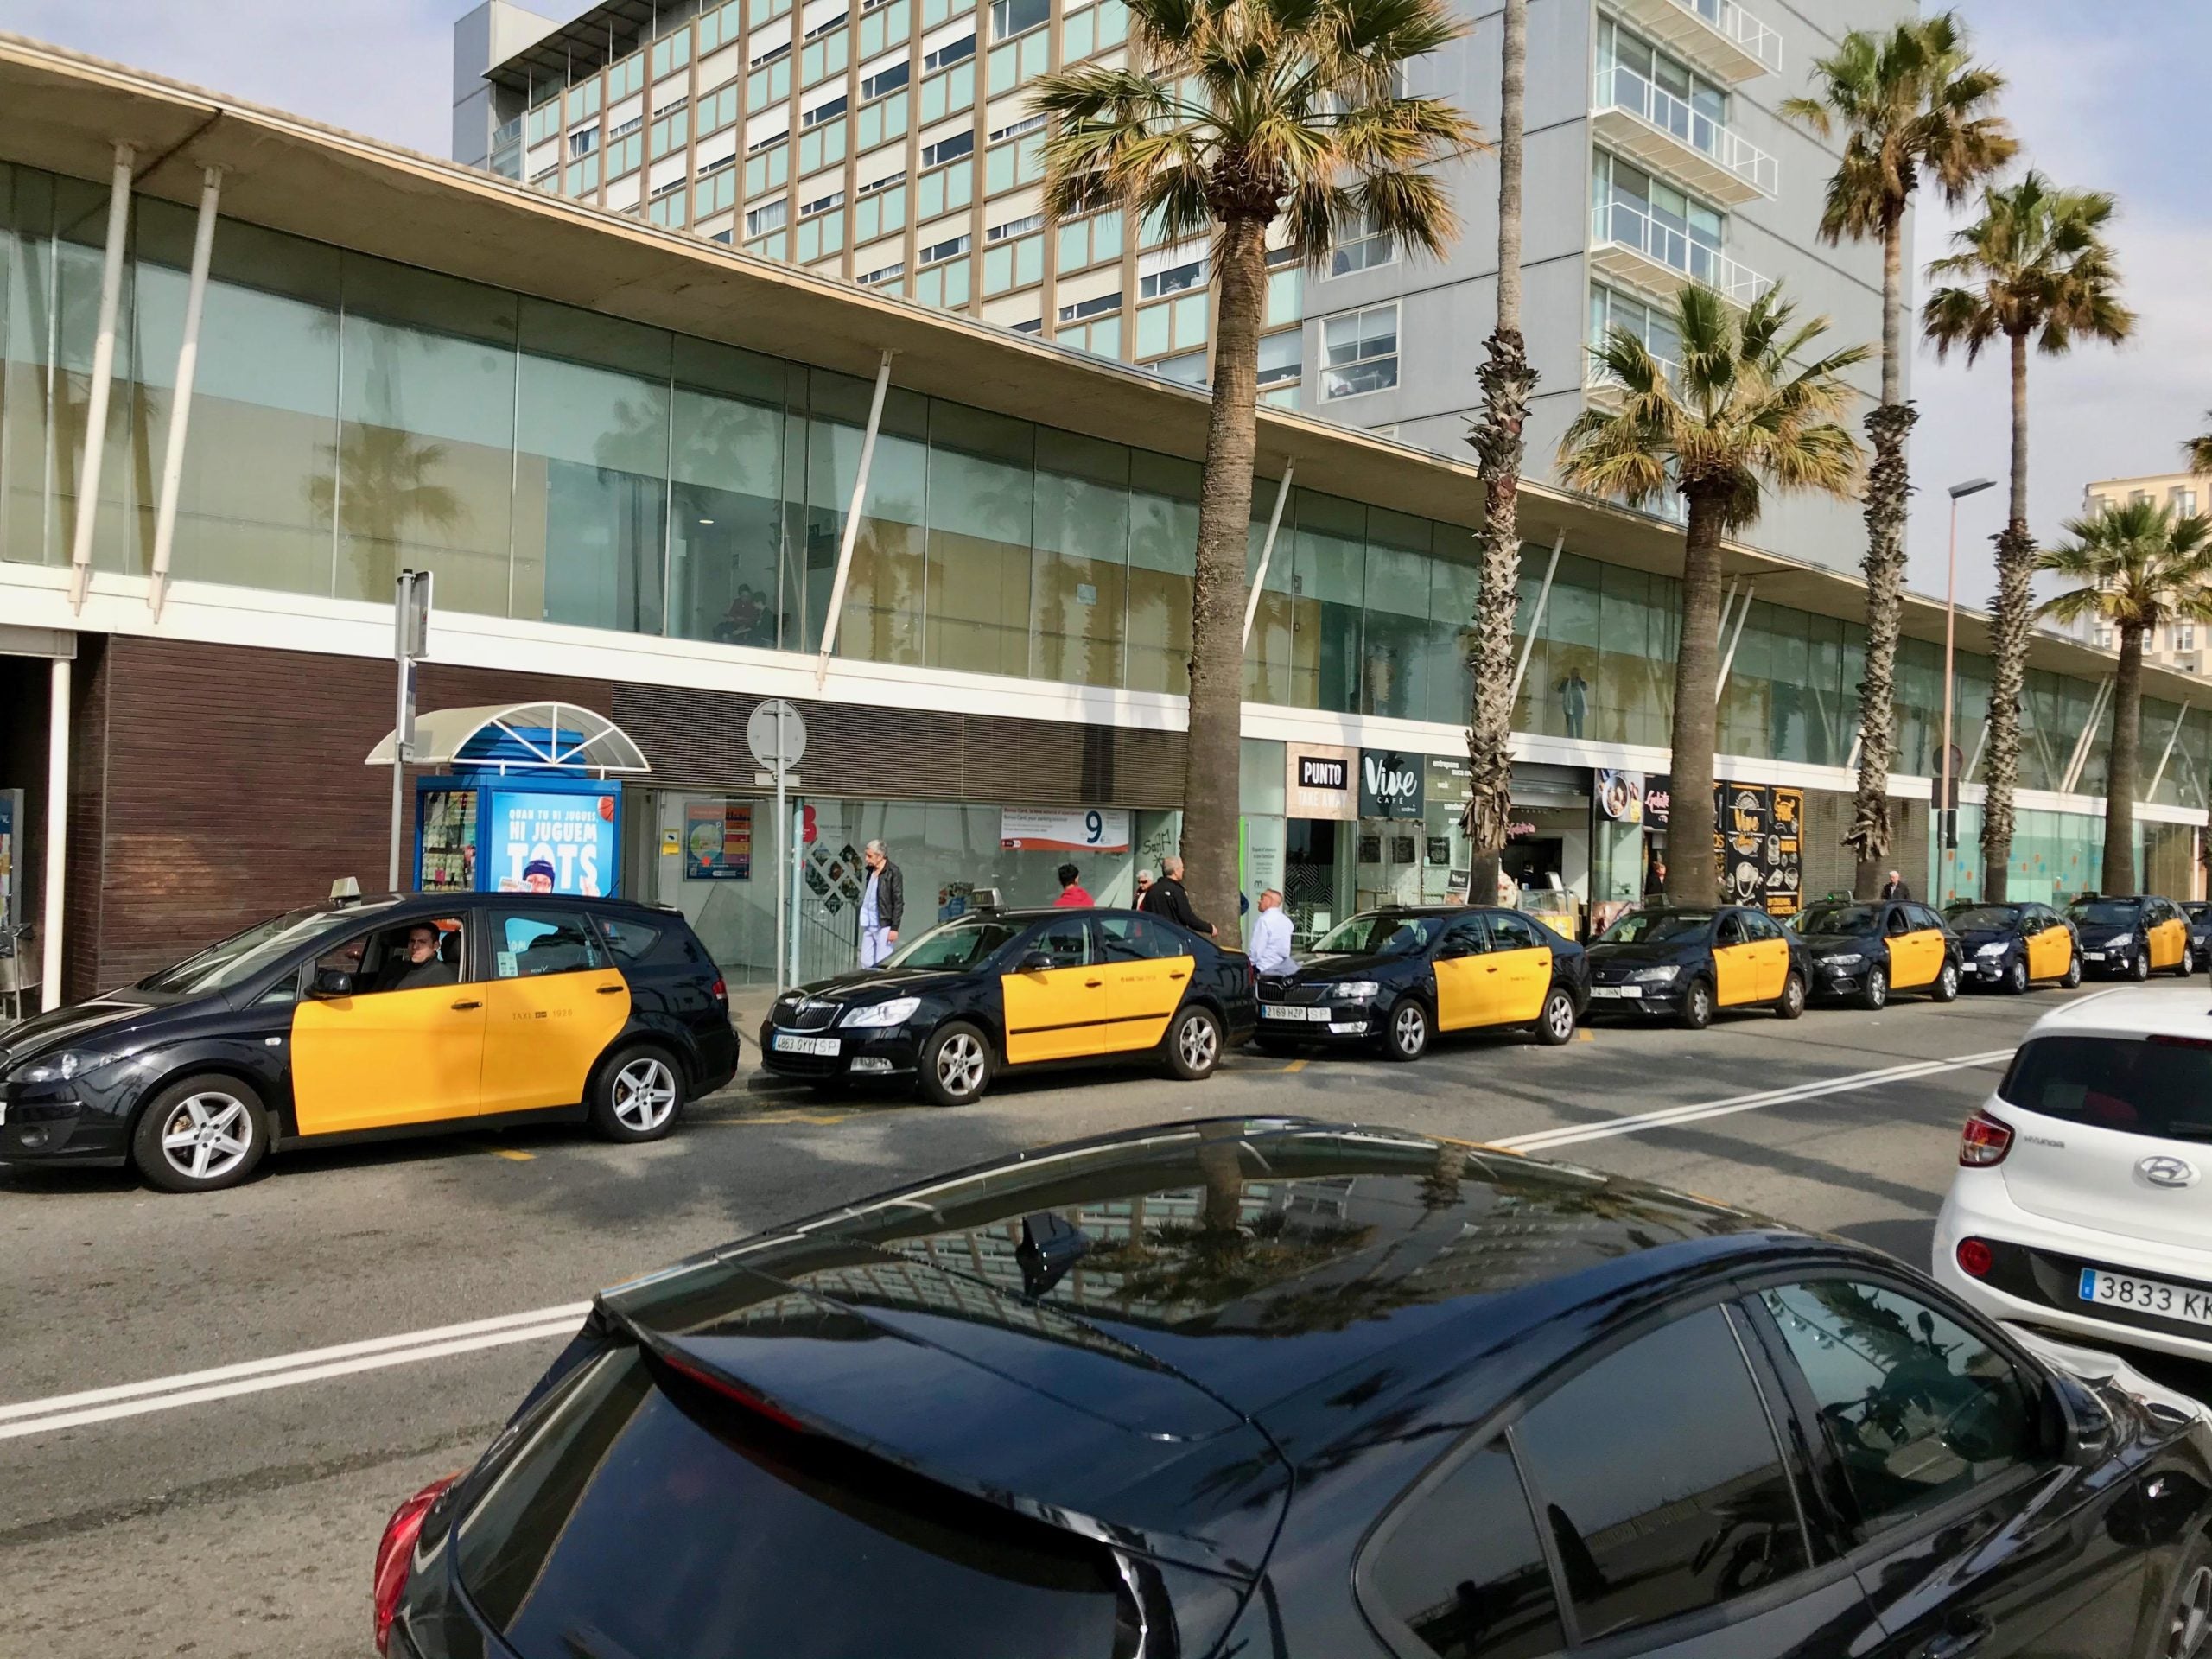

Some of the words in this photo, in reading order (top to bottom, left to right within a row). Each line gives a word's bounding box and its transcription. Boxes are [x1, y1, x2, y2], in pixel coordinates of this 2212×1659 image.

[1304, 761, 1342, 785] PUNTO
[1365, 756, 1417, 797] Vive
[1298, 791, 1319, 807] TAKE
[1322, 791, 1348, 809] AWAY
[1376, 796, 1404, 804] CAFÉ
[509, 809, 534, 820] QUAN
[537, 810, 549, 821] TU
[532, 823, 597, 842] JUGUEM
[1085, 810, 1103, 843] 9
[512, 1012, 531, 1020] TAXI
[1267, 1007, 1286, 1017] 2169
[1310, 1009, 1327, 1019] SP
[777, 1038, 794, 1050] 4863
[797, 1039, 814, 1052] GYY
[819, 1039, 836, 1052] SP
[2100, 1276, 2172, 1311] 3833
